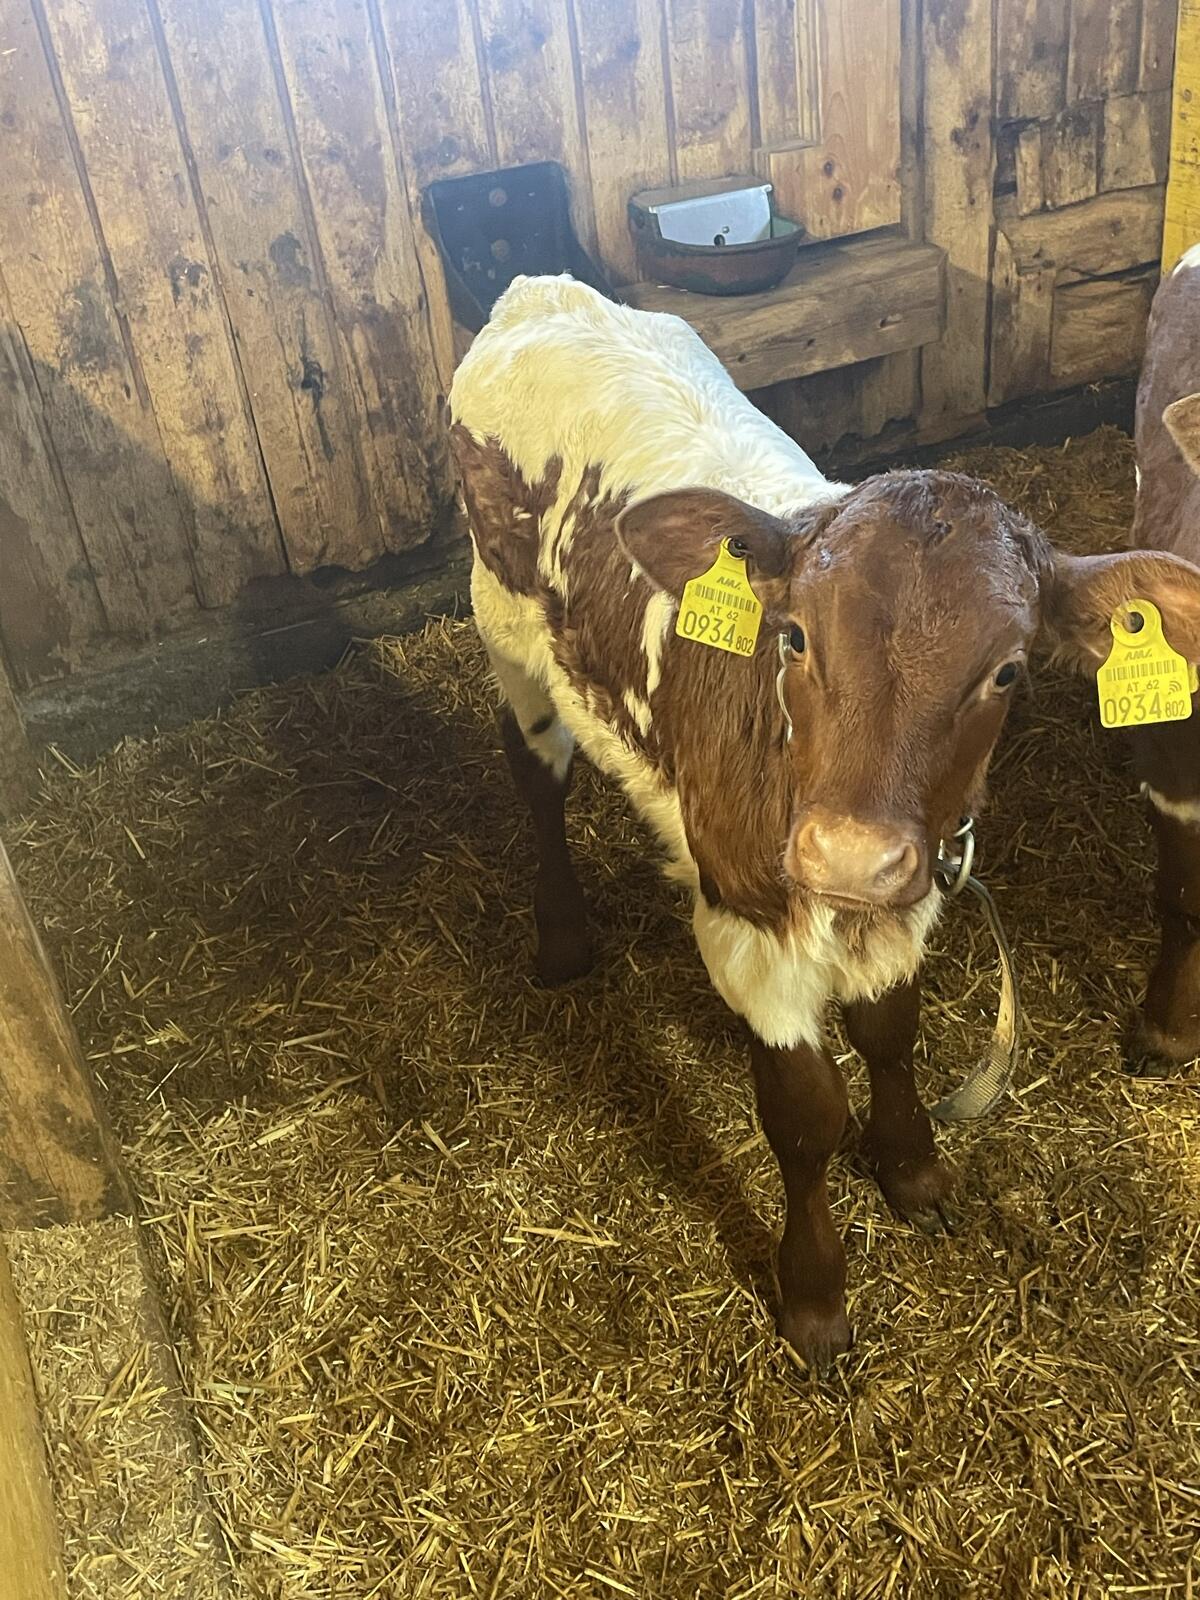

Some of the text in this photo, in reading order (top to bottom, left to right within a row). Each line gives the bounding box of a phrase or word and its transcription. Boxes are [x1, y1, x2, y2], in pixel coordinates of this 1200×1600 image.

[709, 606, 738, 621] AT 62
[684, 611, 753, 653] 0934 802
[1127, 680, 1159, 693] AT 62
[1104, 692, 1185, 724] 0934 802
